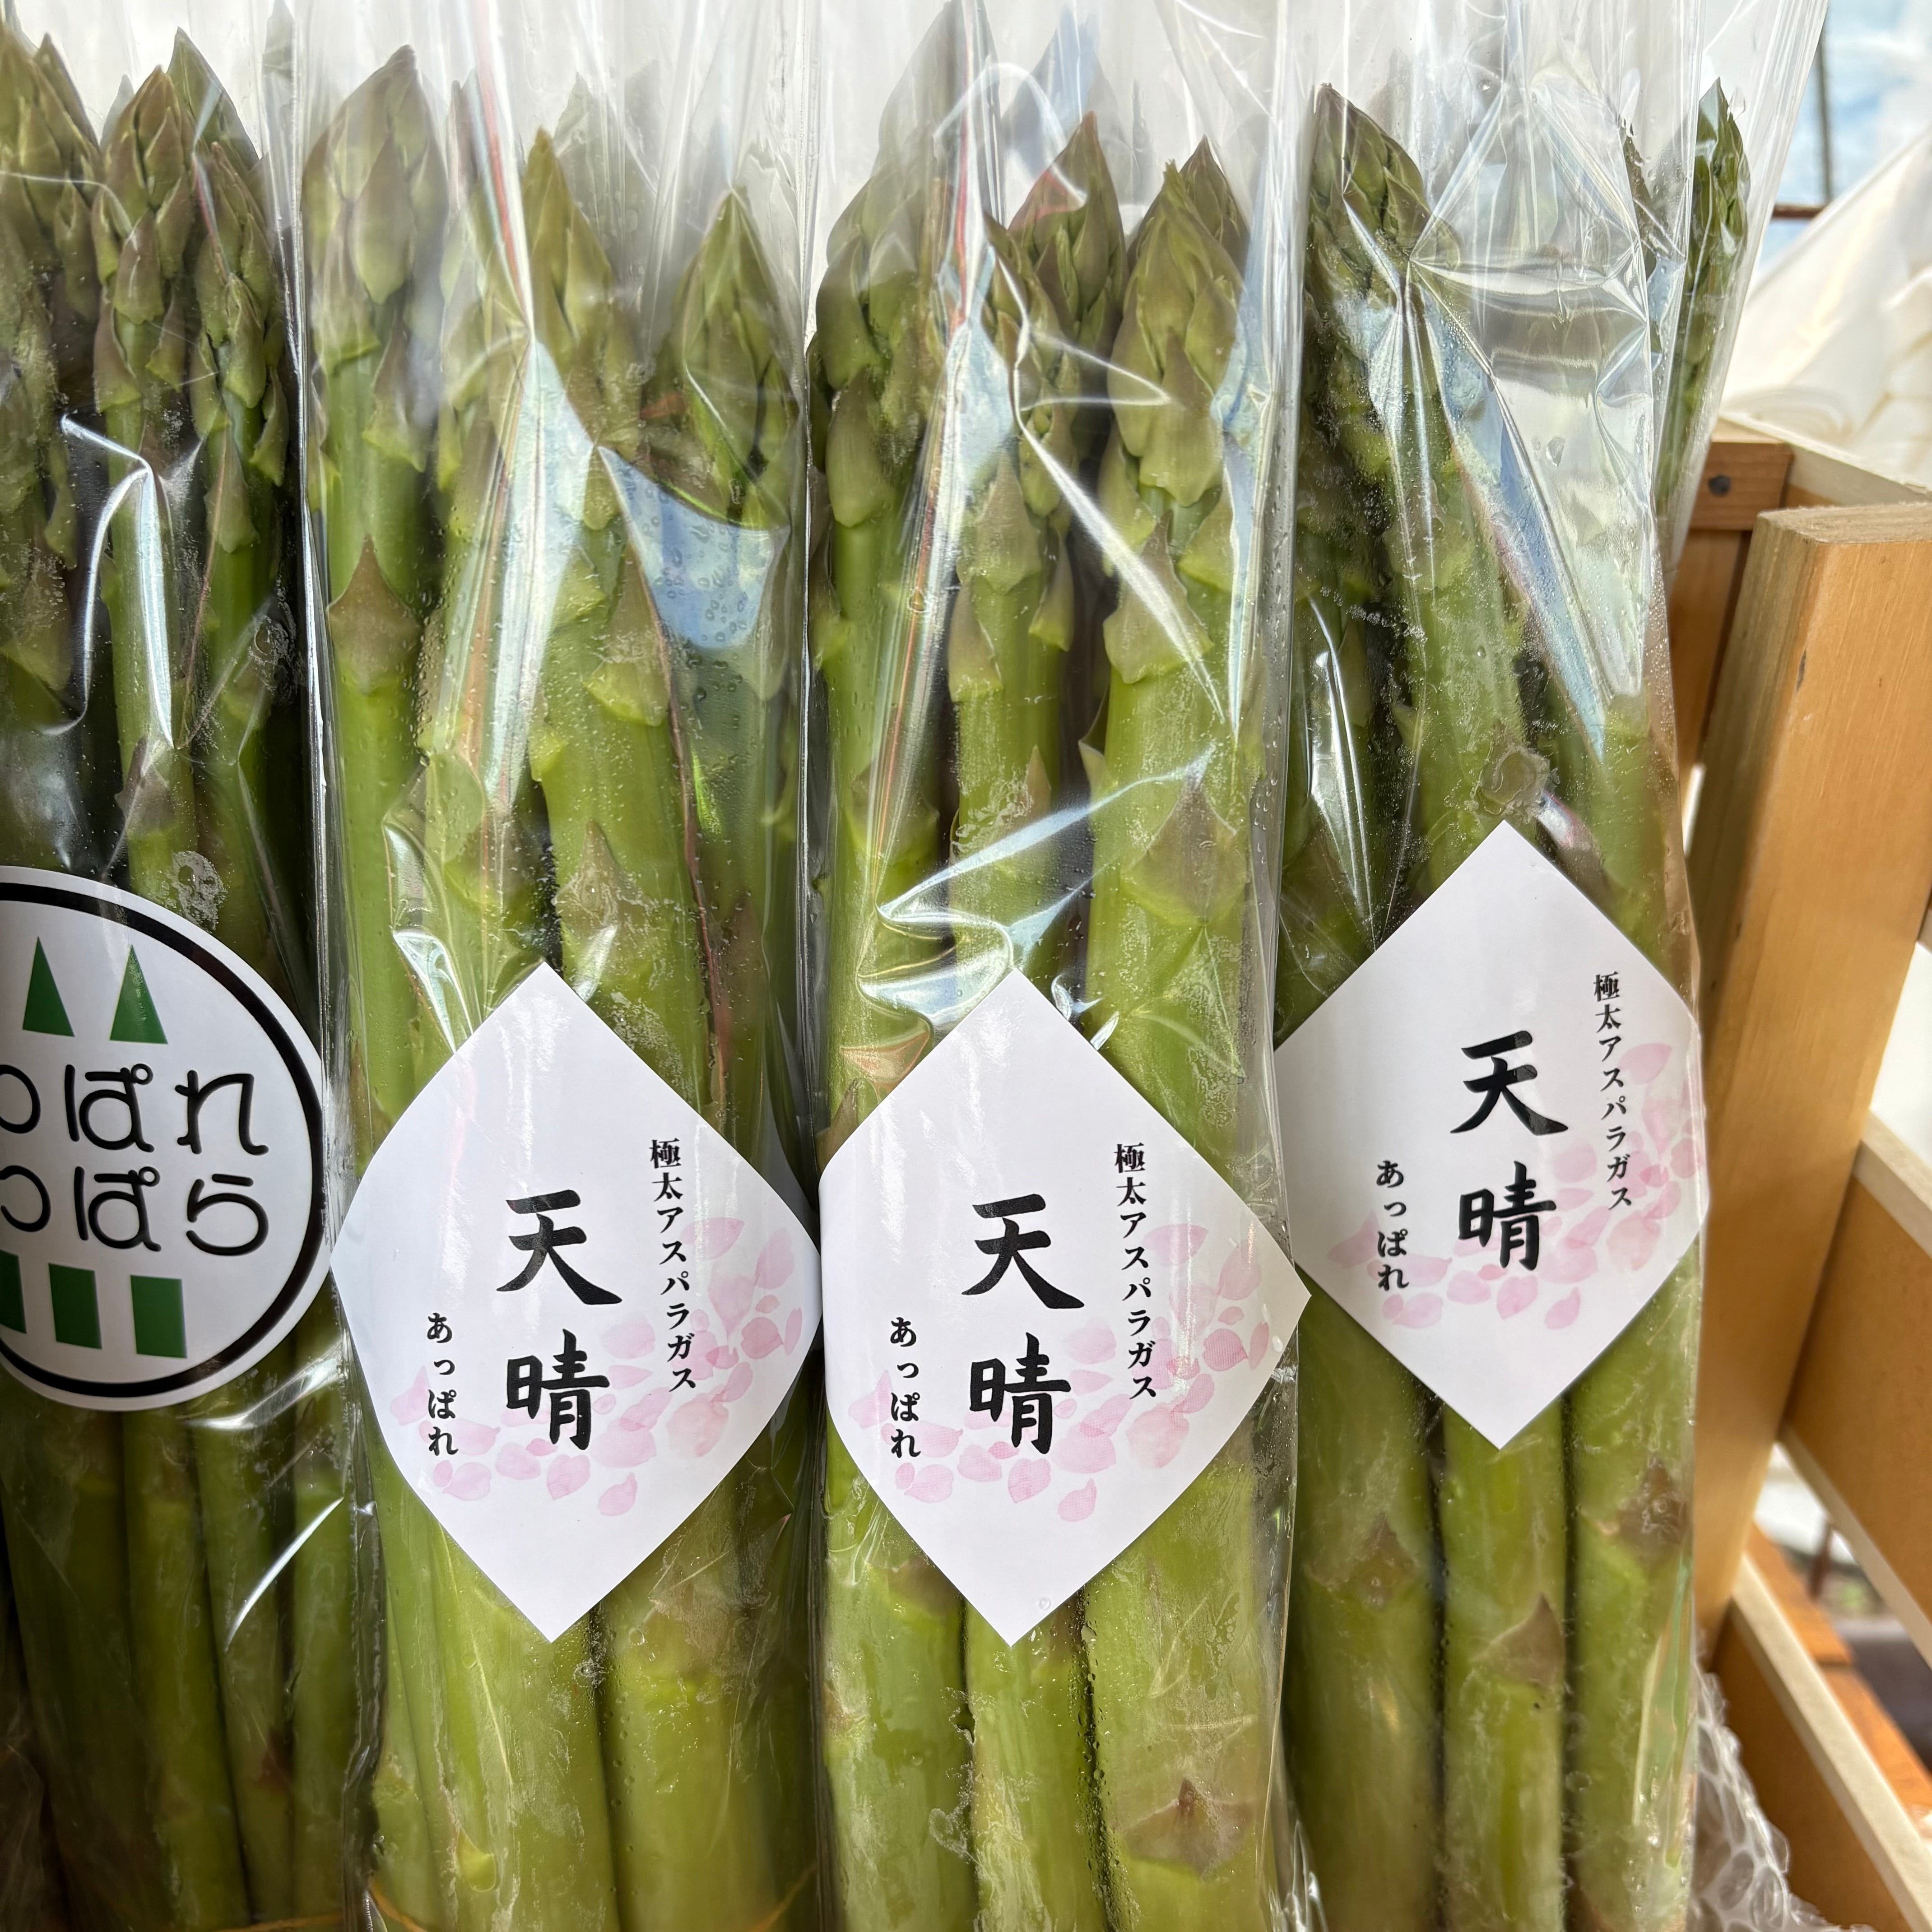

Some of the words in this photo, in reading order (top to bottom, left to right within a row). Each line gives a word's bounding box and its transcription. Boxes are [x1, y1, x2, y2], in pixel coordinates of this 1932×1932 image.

[1450, 1030, 1569, 1271] 天晴
[1594, 971, 1632, 1209] 極太アスパラガス
[496, 1189, 623, 1451] 天晴
[649, 1138, 697, 1393] 極太アスパラガス
[961, 1193, 1085, 1455] 天晴
[1114, 1142, 1156, 1400] 極太アスパラガス
[1376, 1160, 1410, 1292] あっぱれ
[427, 1312, 459, 1457] あっぱれ
[890, 1316, 921, 1458] あっぱれ
